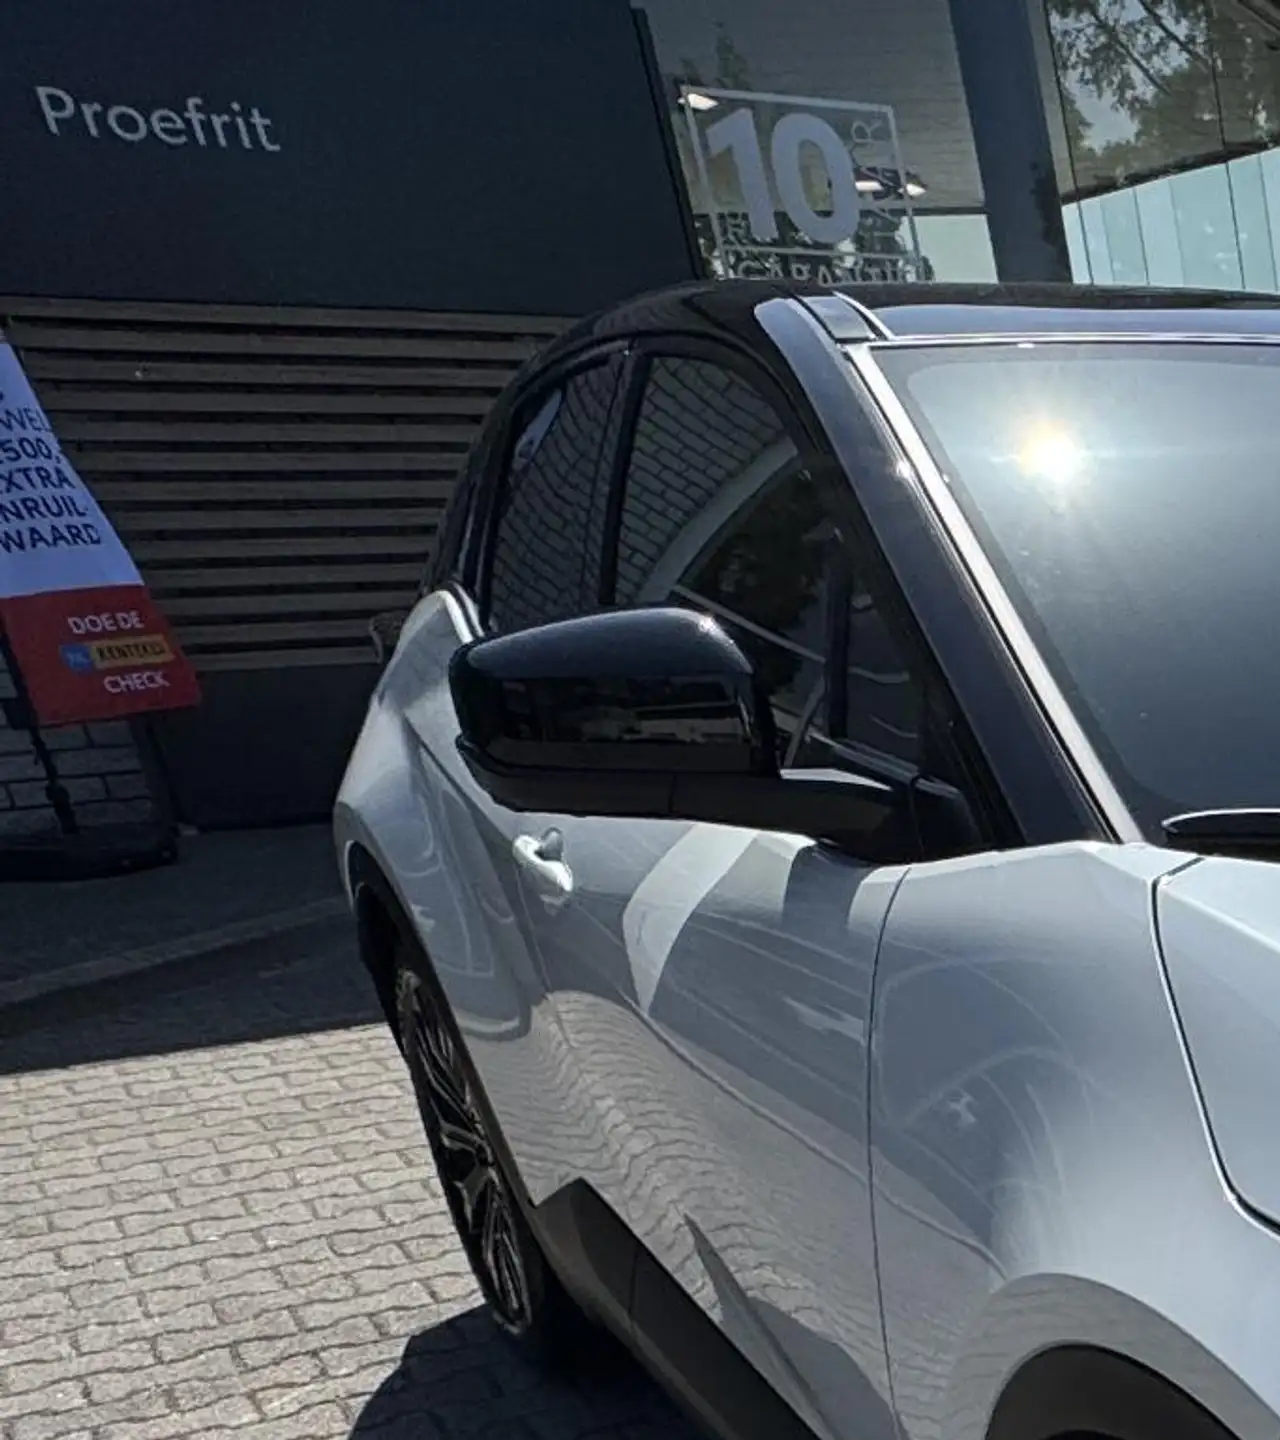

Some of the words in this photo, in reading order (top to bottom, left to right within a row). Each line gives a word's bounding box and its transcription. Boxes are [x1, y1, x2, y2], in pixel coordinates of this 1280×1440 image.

[35, 86, 281, 152] Proefrit
[705, 107, 860, 244] 10
[0, 465, 77, 495] XTRA
[67, 611, 117, 635] DOE
[115, 608, 145, 629] DE
[103, 670, 171, 694] CHECK
